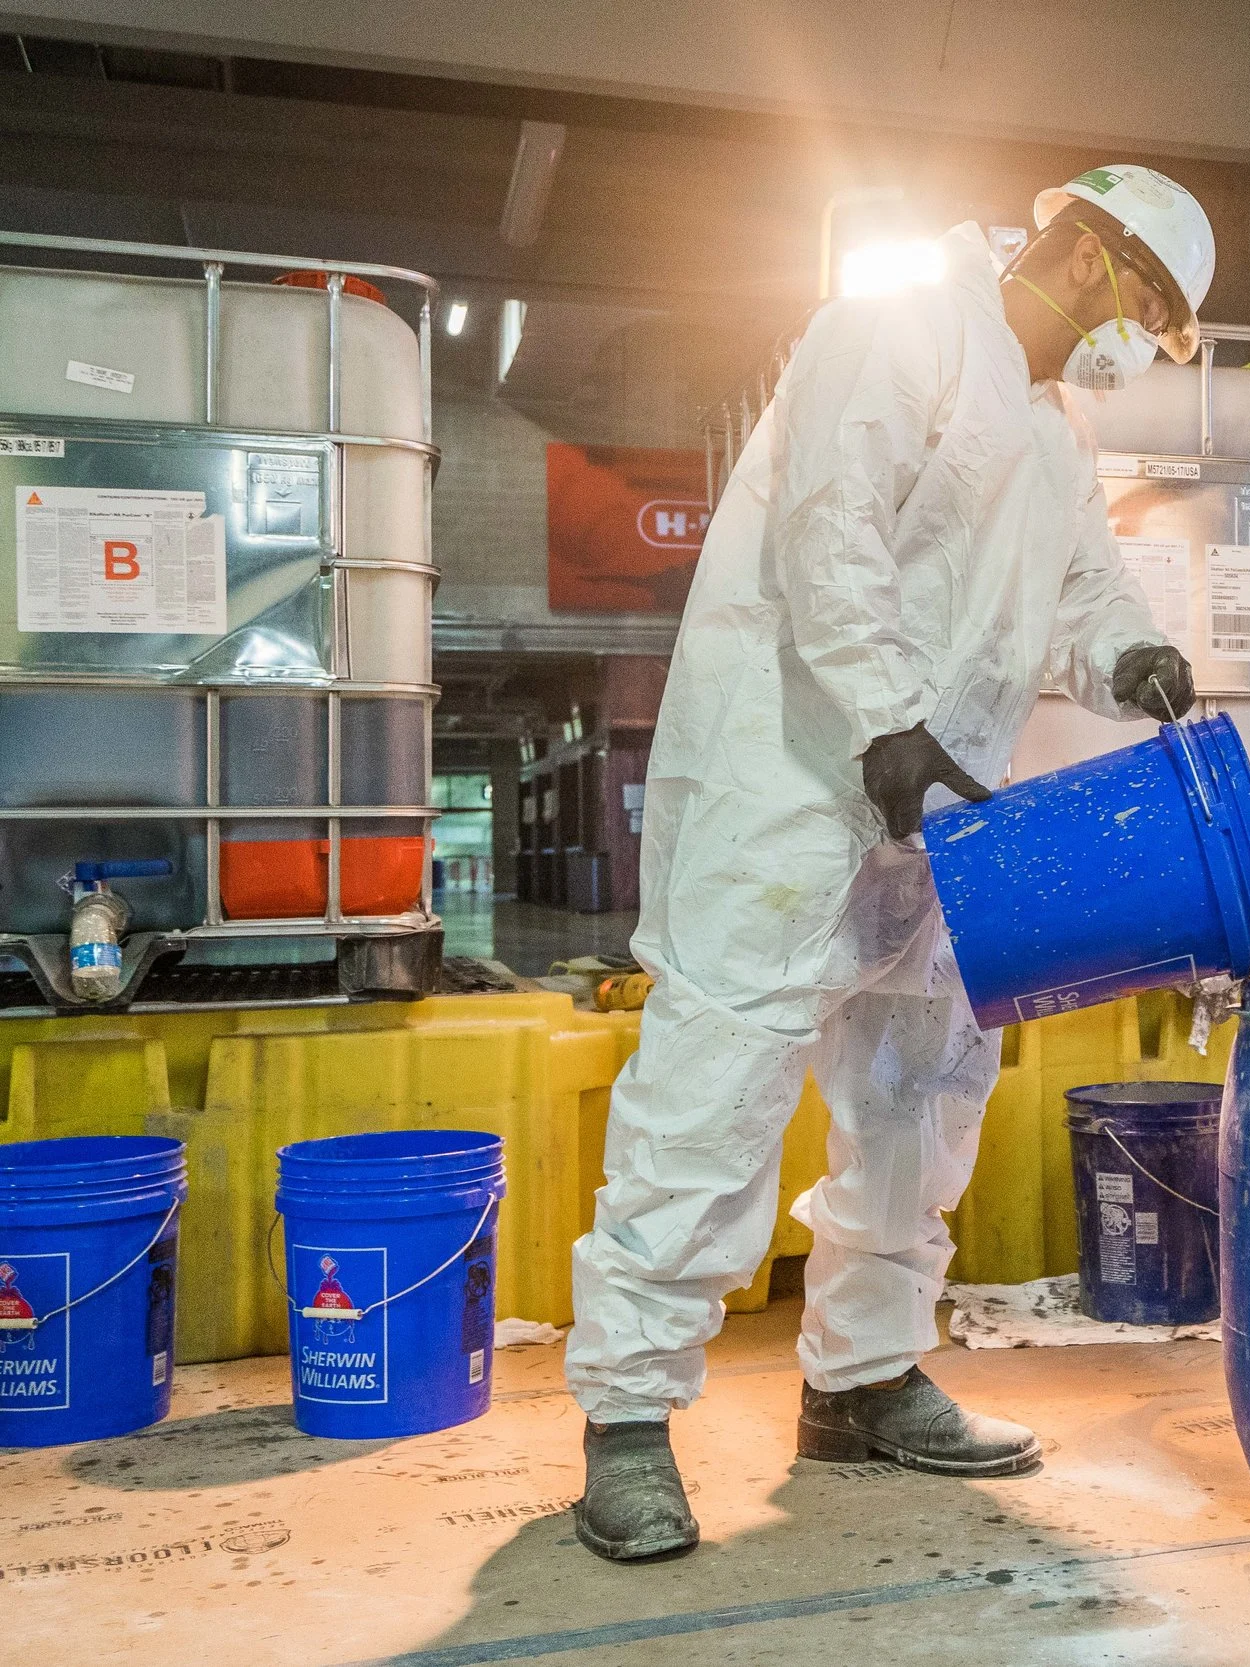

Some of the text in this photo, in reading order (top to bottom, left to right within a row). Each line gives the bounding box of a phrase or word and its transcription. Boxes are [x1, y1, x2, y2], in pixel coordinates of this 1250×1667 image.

[104, 541, 141, 581] B
[301, 1345, 376, 1368] SHERWIN
[301, 1365, 377, 1390] WILLIAMS
[436, 1500, 577, 1526] ORSHELL
[0, 1541, 213, 1580] FLOORSHEL
